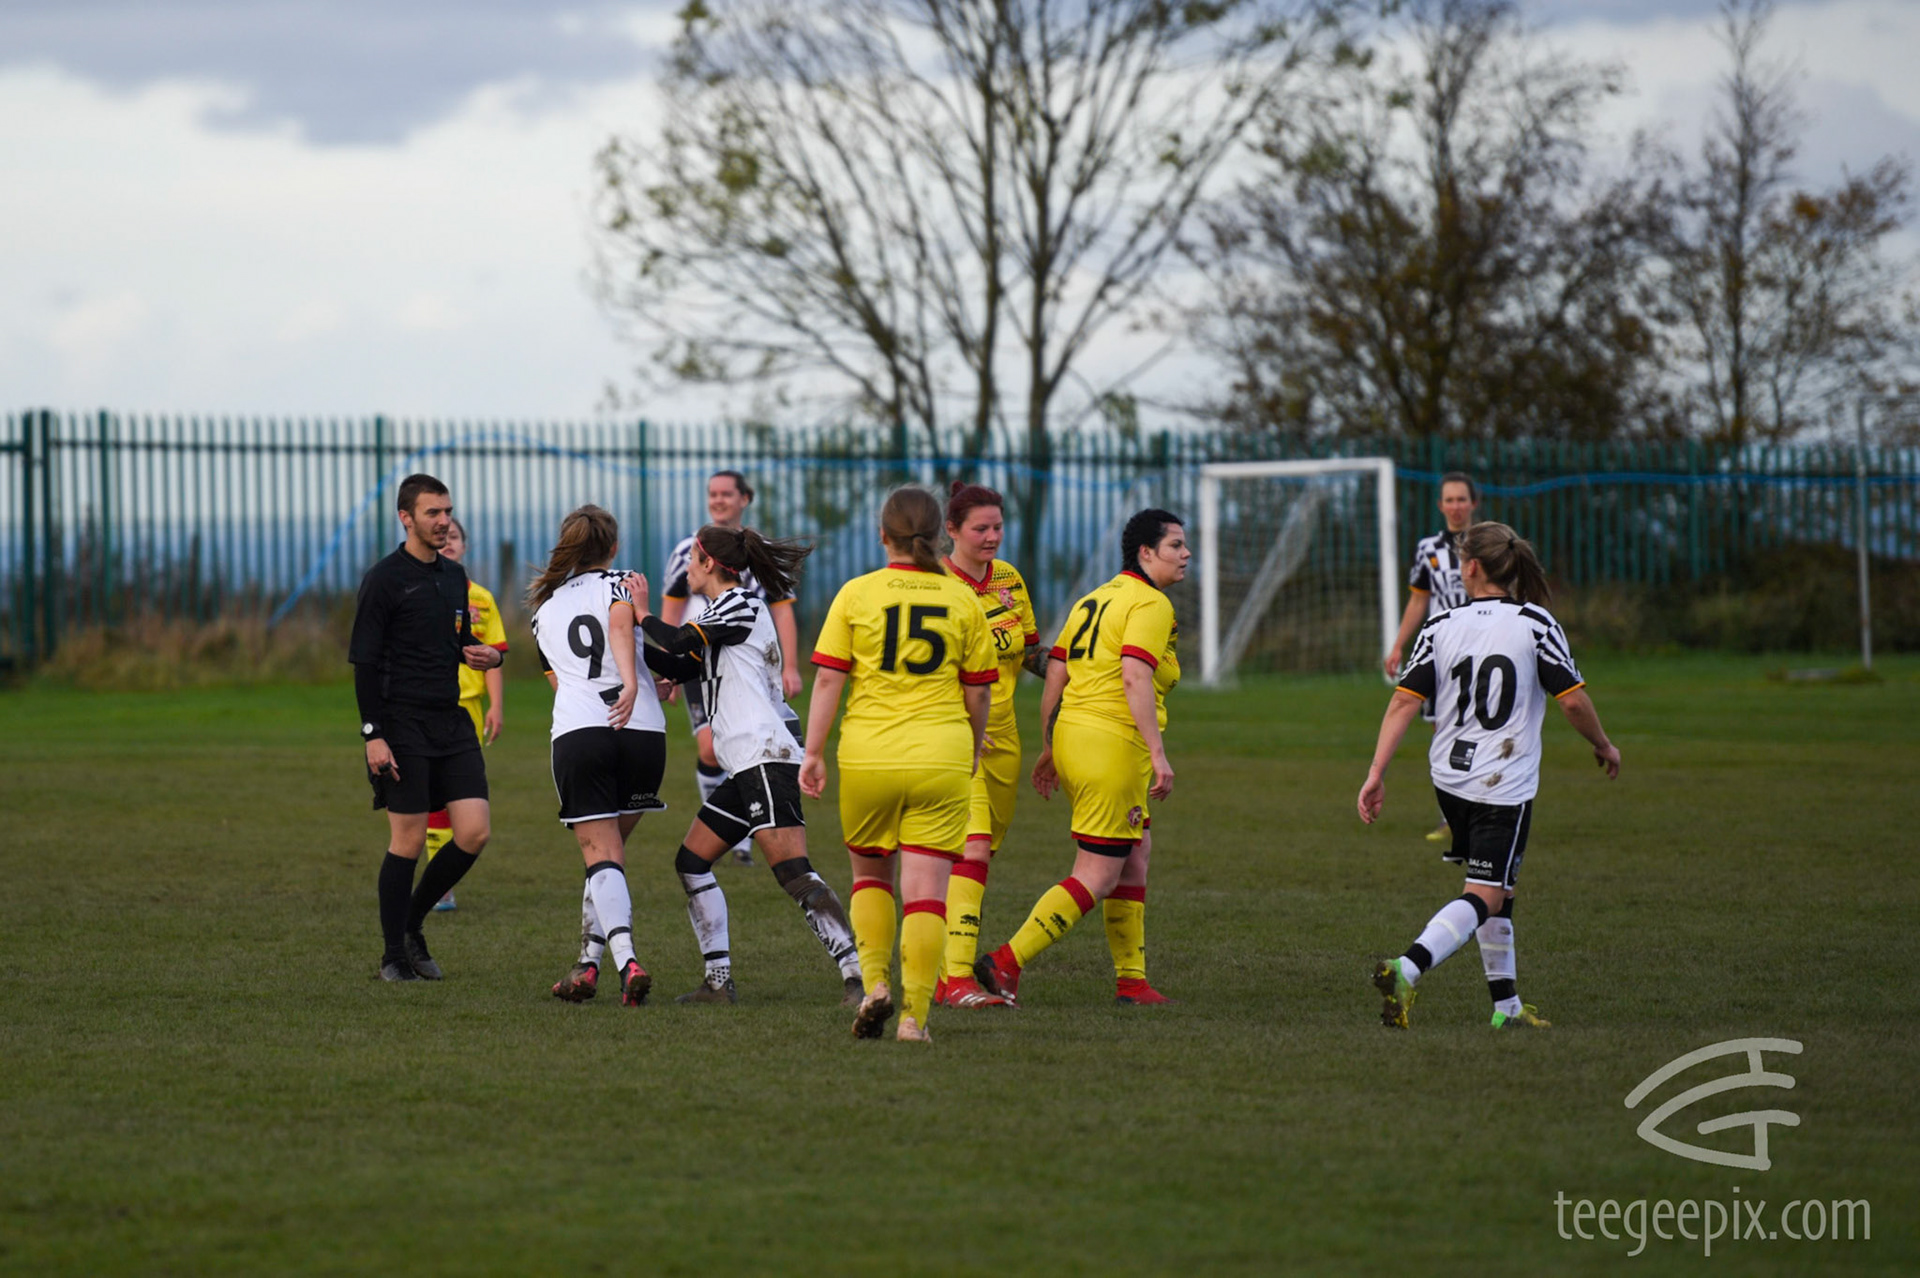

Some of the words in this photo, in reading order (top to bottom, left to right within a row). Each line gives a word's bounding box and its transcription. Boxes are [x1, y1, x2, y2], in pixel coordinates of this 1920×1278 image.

[567, 614, 606, 680] 9
[880, 602, 949, 675] 15
[1068, 598, 1113, 660] 21
[1451, 653, 1517, 731] 10
